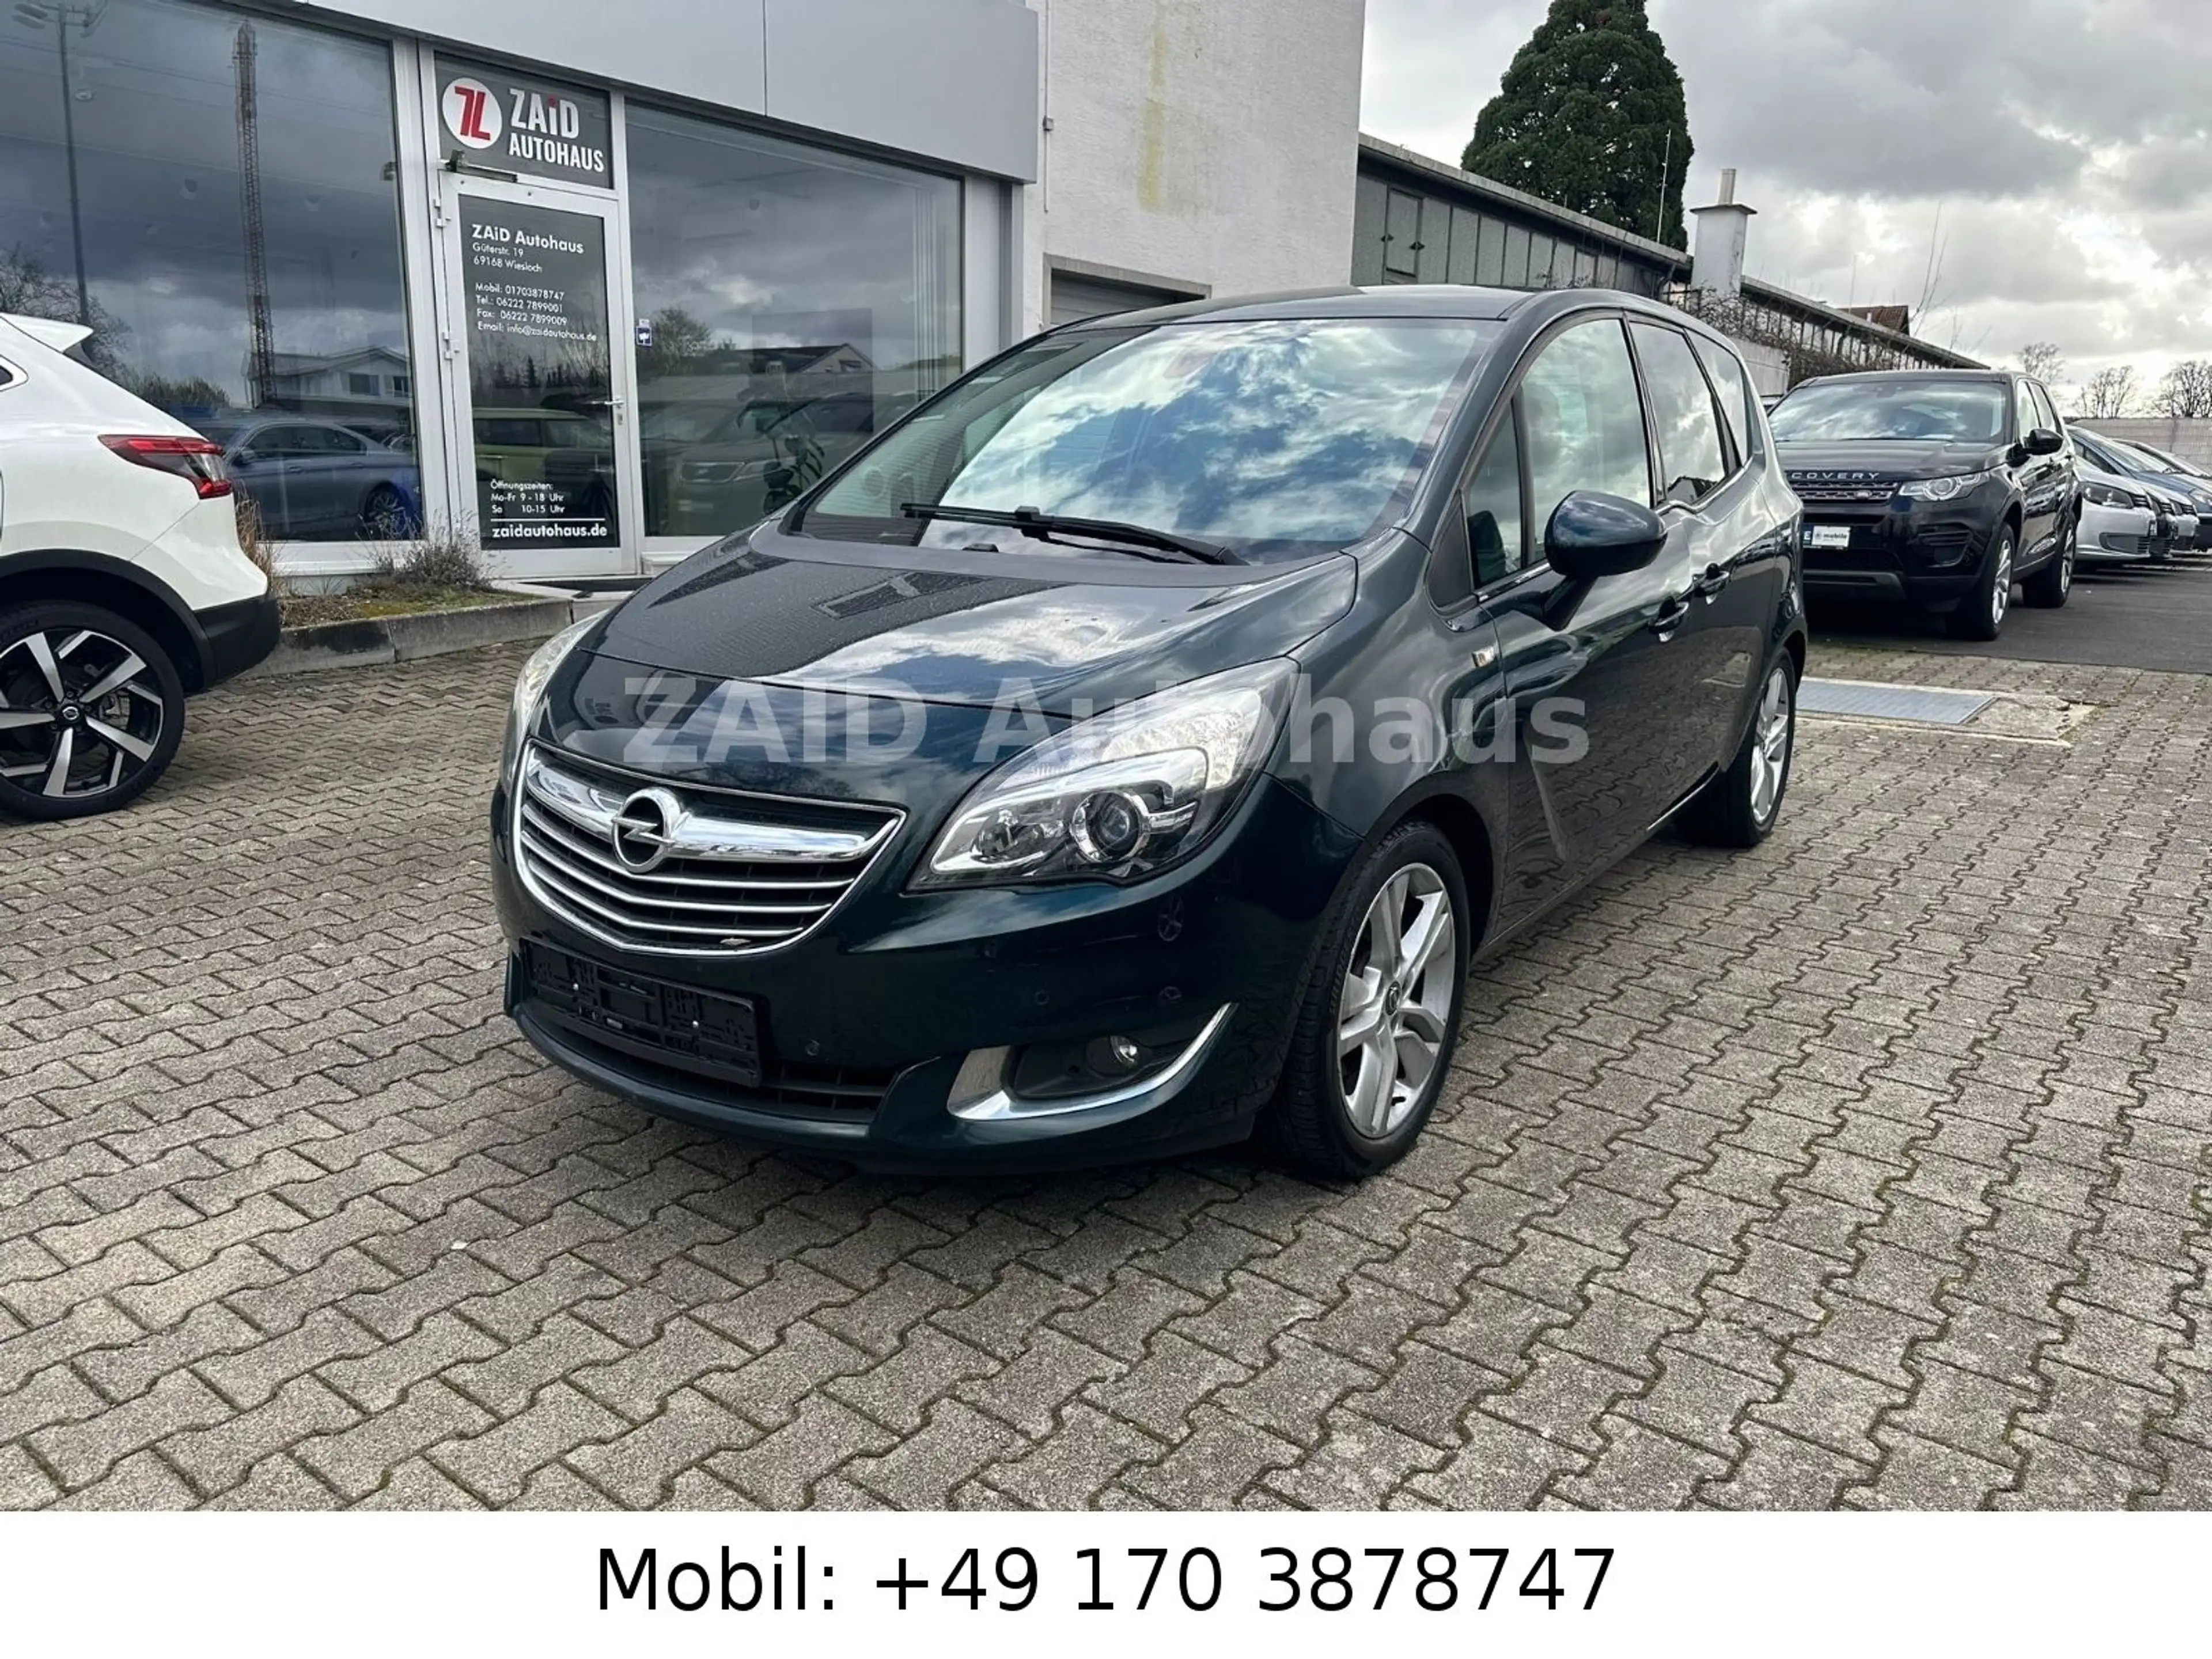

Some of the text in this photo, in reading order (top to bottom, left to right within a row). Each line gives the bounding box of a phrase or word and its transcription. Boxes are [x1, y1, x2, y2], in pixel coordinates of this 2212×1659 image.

[508, 132, 604, 172] AUTOHAUS
[515, 230, 584, 254] Autohaus
[513, 248, 524, 257] 19
[474, 255, 543, 274] 69168 Wiesloch
[475, 282, 565, 301] Mobil: 01703878747
[496, 297, 524, 309] 06222
[527, 300, 562, 313] 7899001
[477, 308, 567, 325] Fax: 06222 7899009
[478, 321, 504, 332] Email:
[490, 479, 554, 491] Öffnungszeiten:
[491, 493, 516, 502] Mo-Fr
[520, 493, 526, 501] 9
[535, 493, 544, 501] 18
[549, 493, 564, 501] Uhr
[521, 505, 546, 513] 10-15
[550, 505, 565, 513] Uhr
[492, 523, 607, 538] zaidautohaus.de
